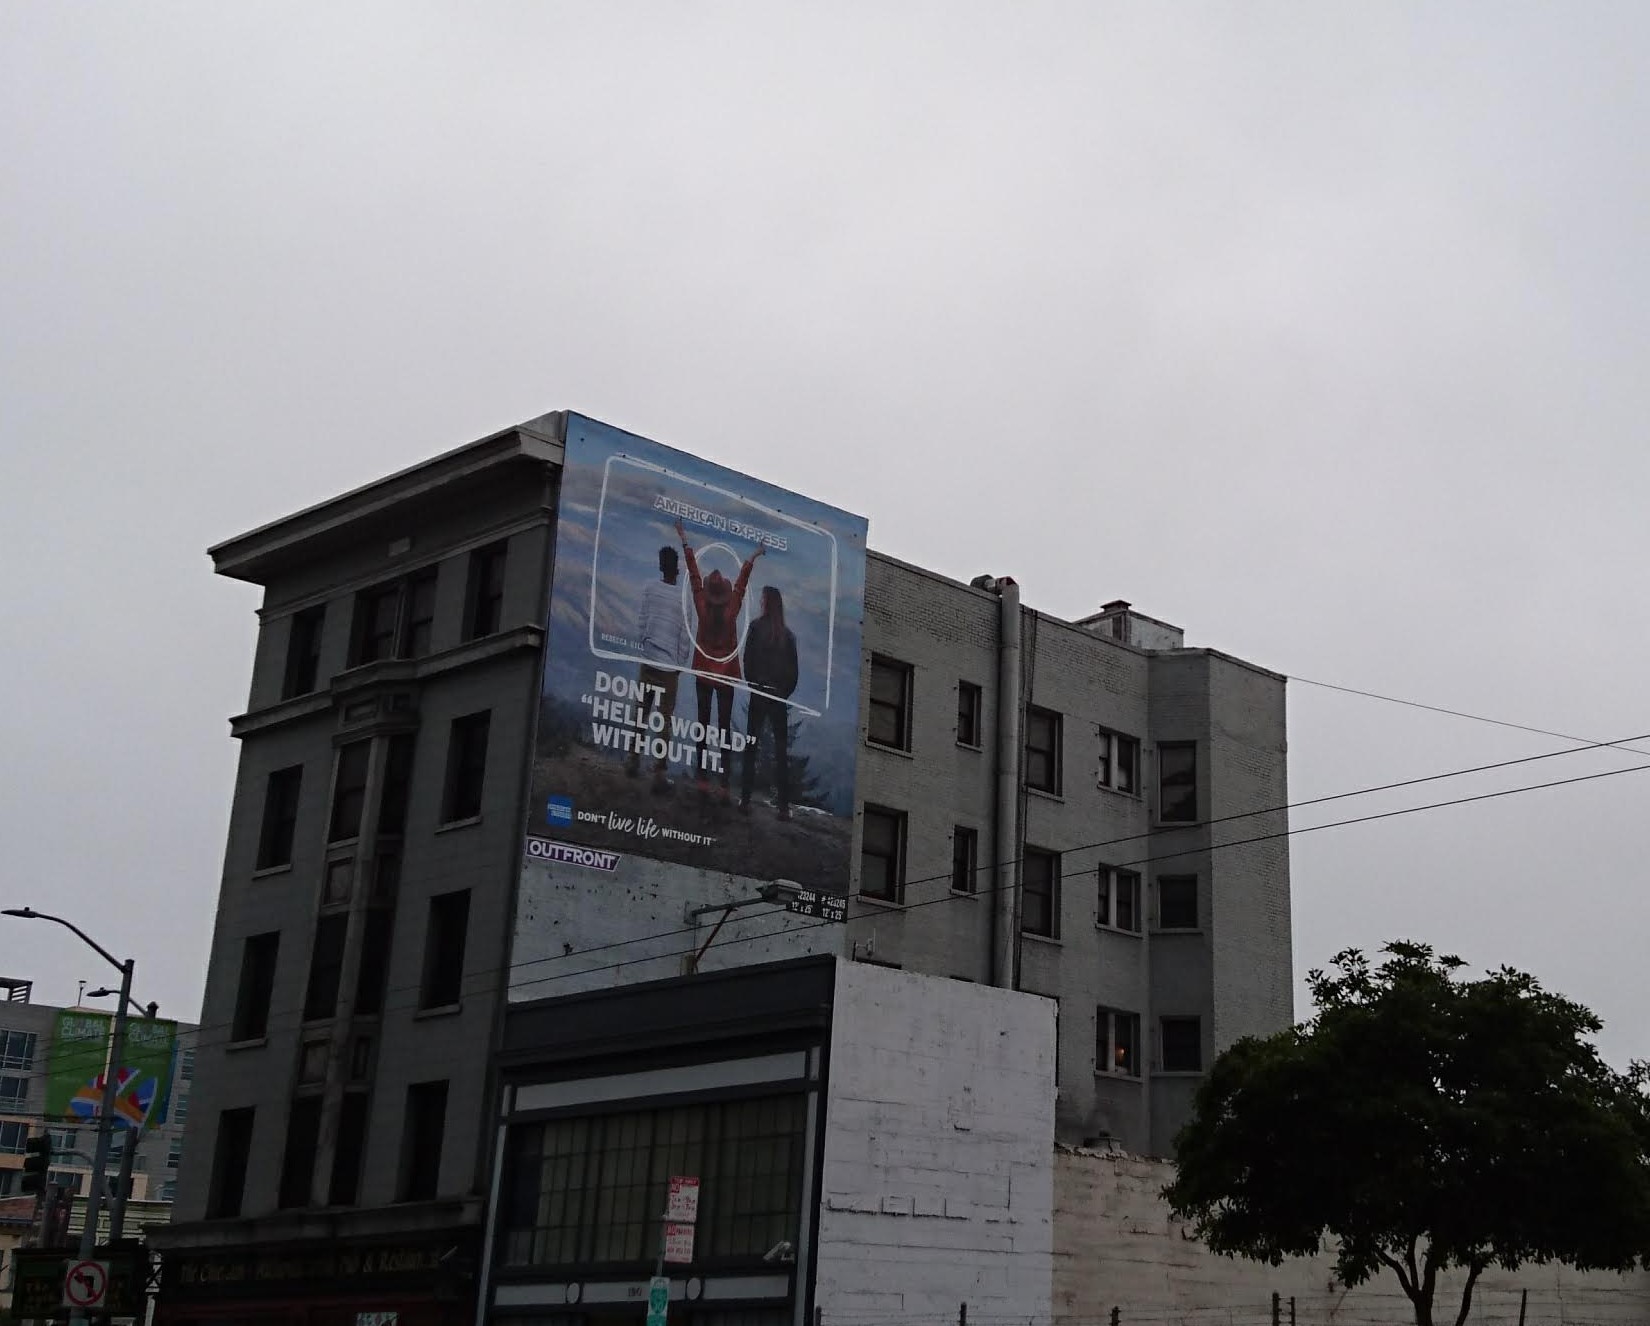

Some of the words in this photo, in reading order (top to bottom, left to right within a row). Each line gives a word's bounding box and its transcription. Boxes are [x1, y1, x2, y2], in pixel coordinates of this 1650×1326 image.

[654, 495, 727, 532] AMERICAN
[728, 518, 788, 552] EXPRESS
[594, 671, 666, 707] DON'T
[592, 722, 697, 766] WITHOUT
[701, 749, 725, 774] IT.
[577, 810, 607, 825] DON'T
[608, 811, 635, 833] live
[636, 817, 660, 840] life
[661, 828, 702, 844] WITHOUT
[529, 840, 616, 869] OUTFRONT
